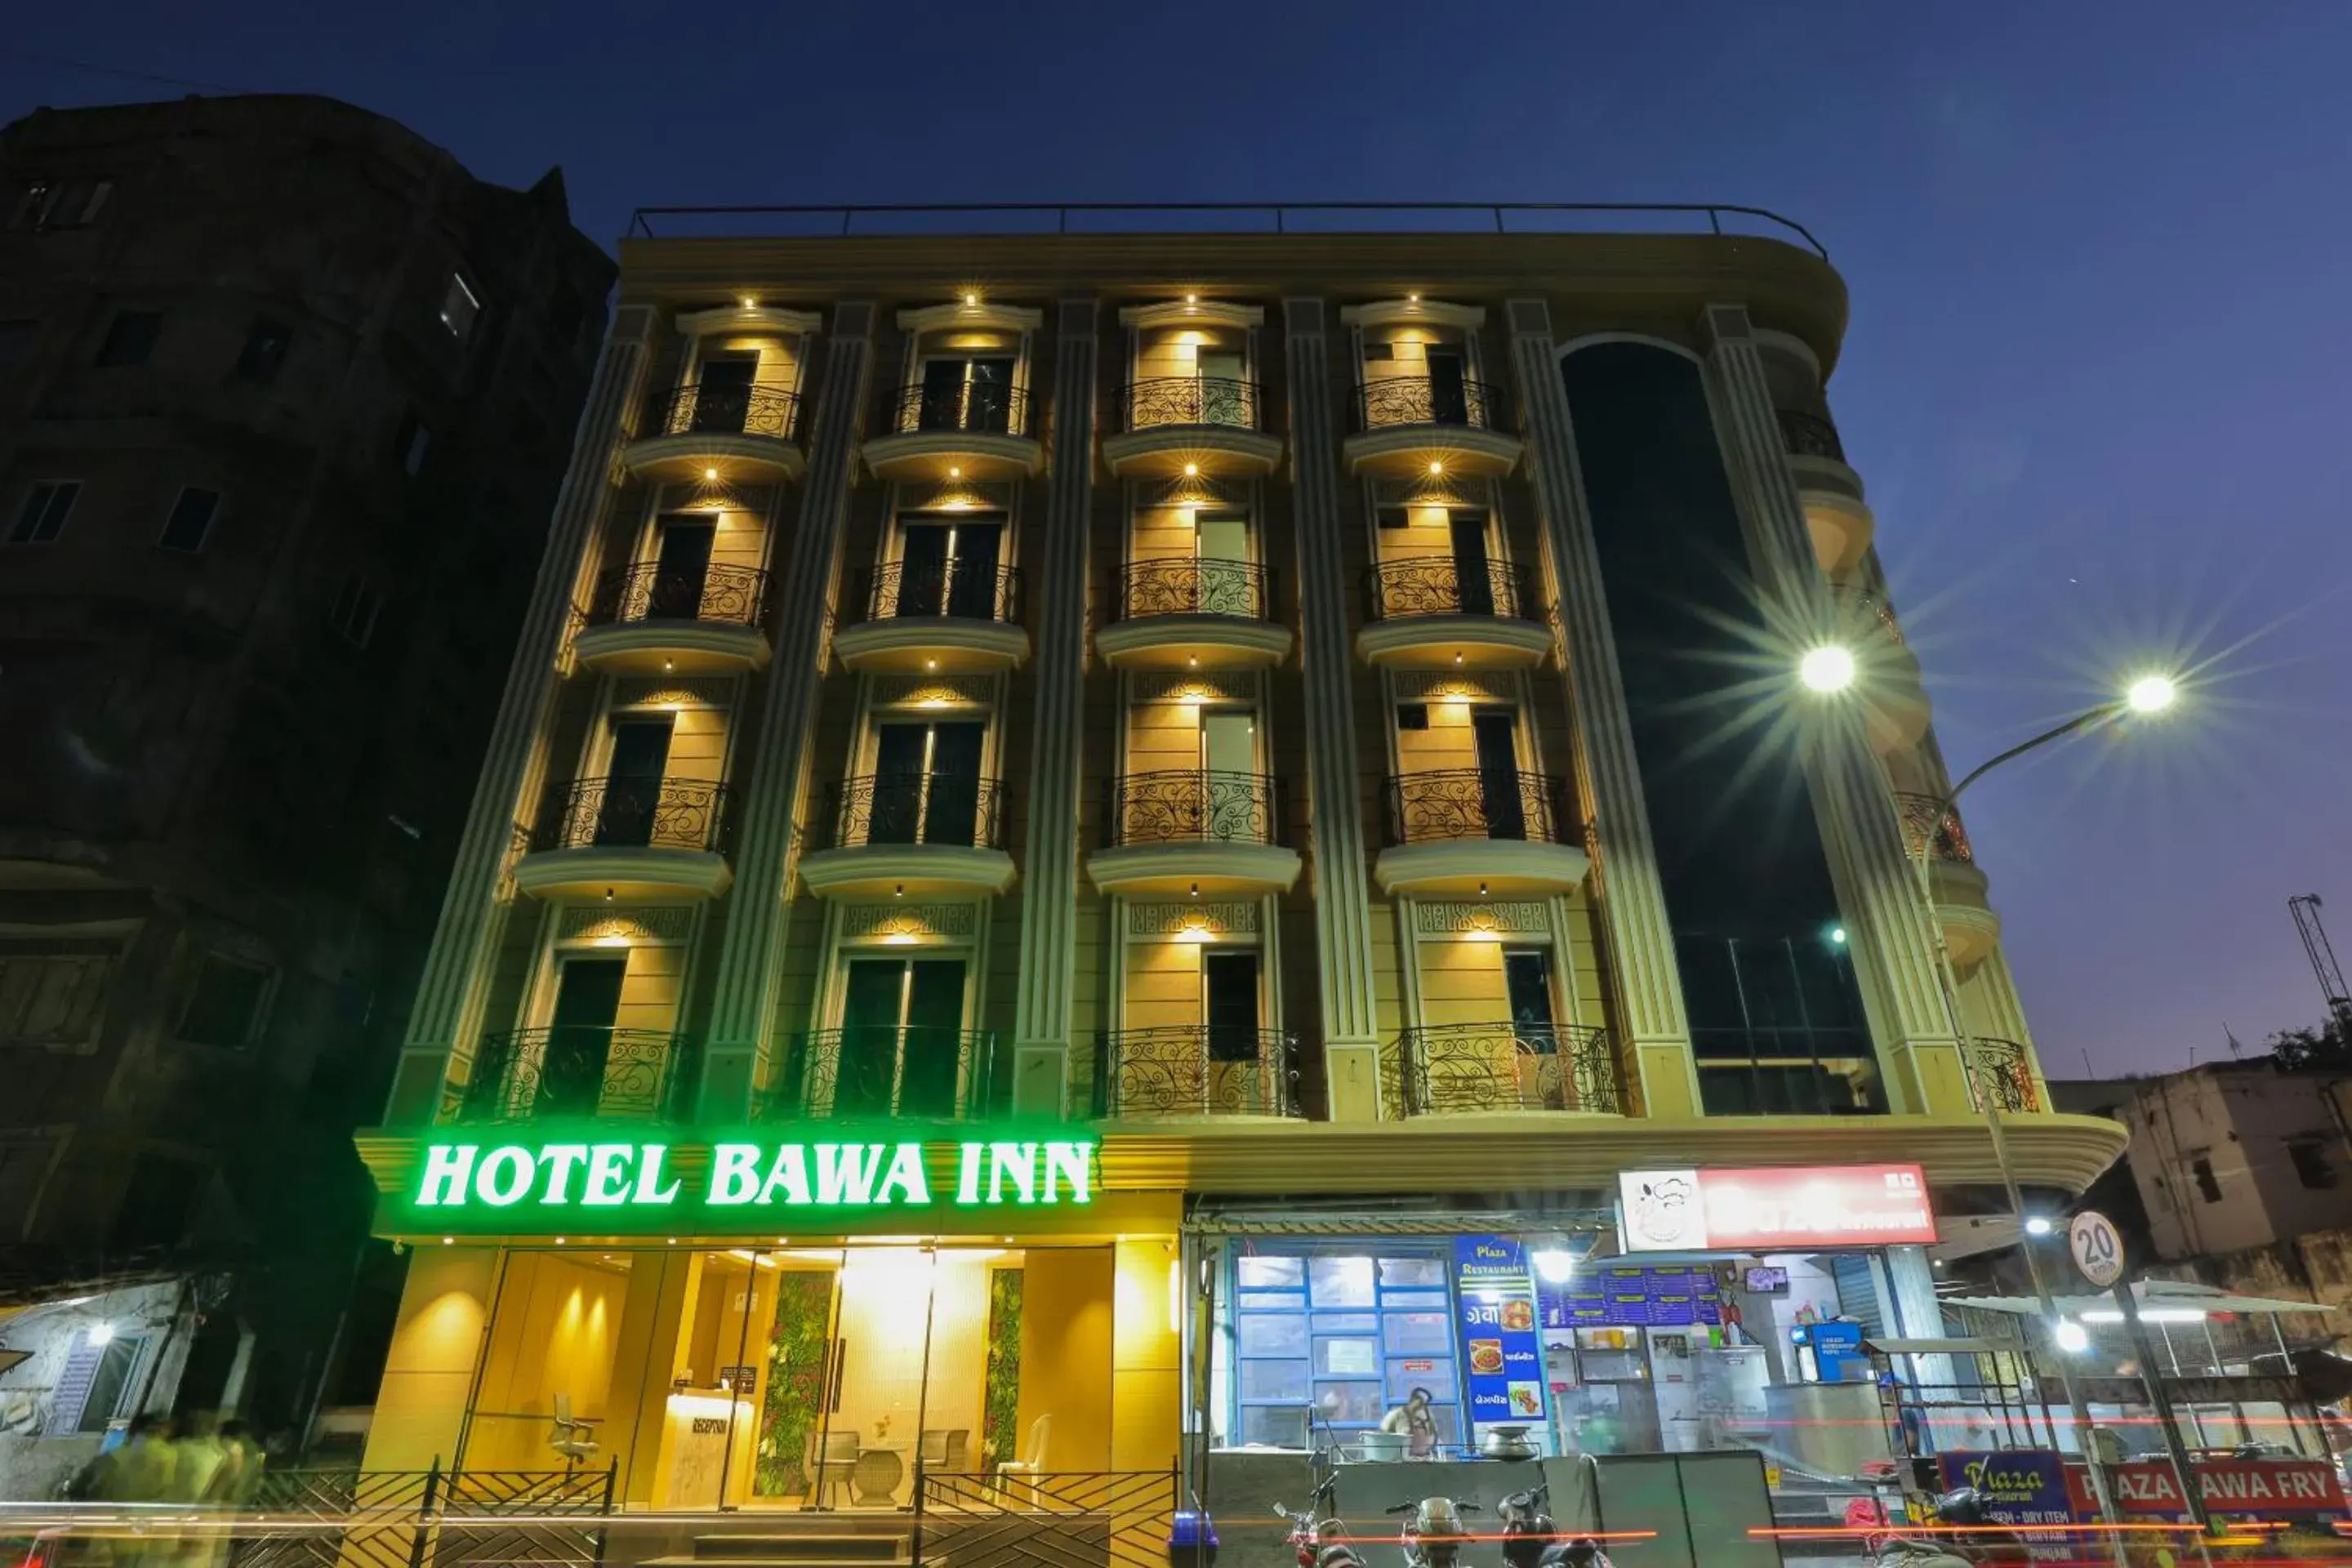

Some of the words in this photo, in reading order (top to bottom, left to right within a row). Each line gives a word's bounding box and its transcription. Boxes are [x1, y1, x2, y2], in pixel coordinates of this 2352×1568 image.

[414, 1144, 681, 1206] HOTEL
[705, 1143, 931, 1205] BAWA
[956, 1143, 1094, 1204] INN
[2077, 1223, 2114, 1264] 20
[2082, 1473, 2177, 1500] PAZA
[2193, 1472, 2274, 1499] AWA
[2274, 1472, 2328, 1499] FRY
[2044, 1511, 2069, 1524] ITEM
